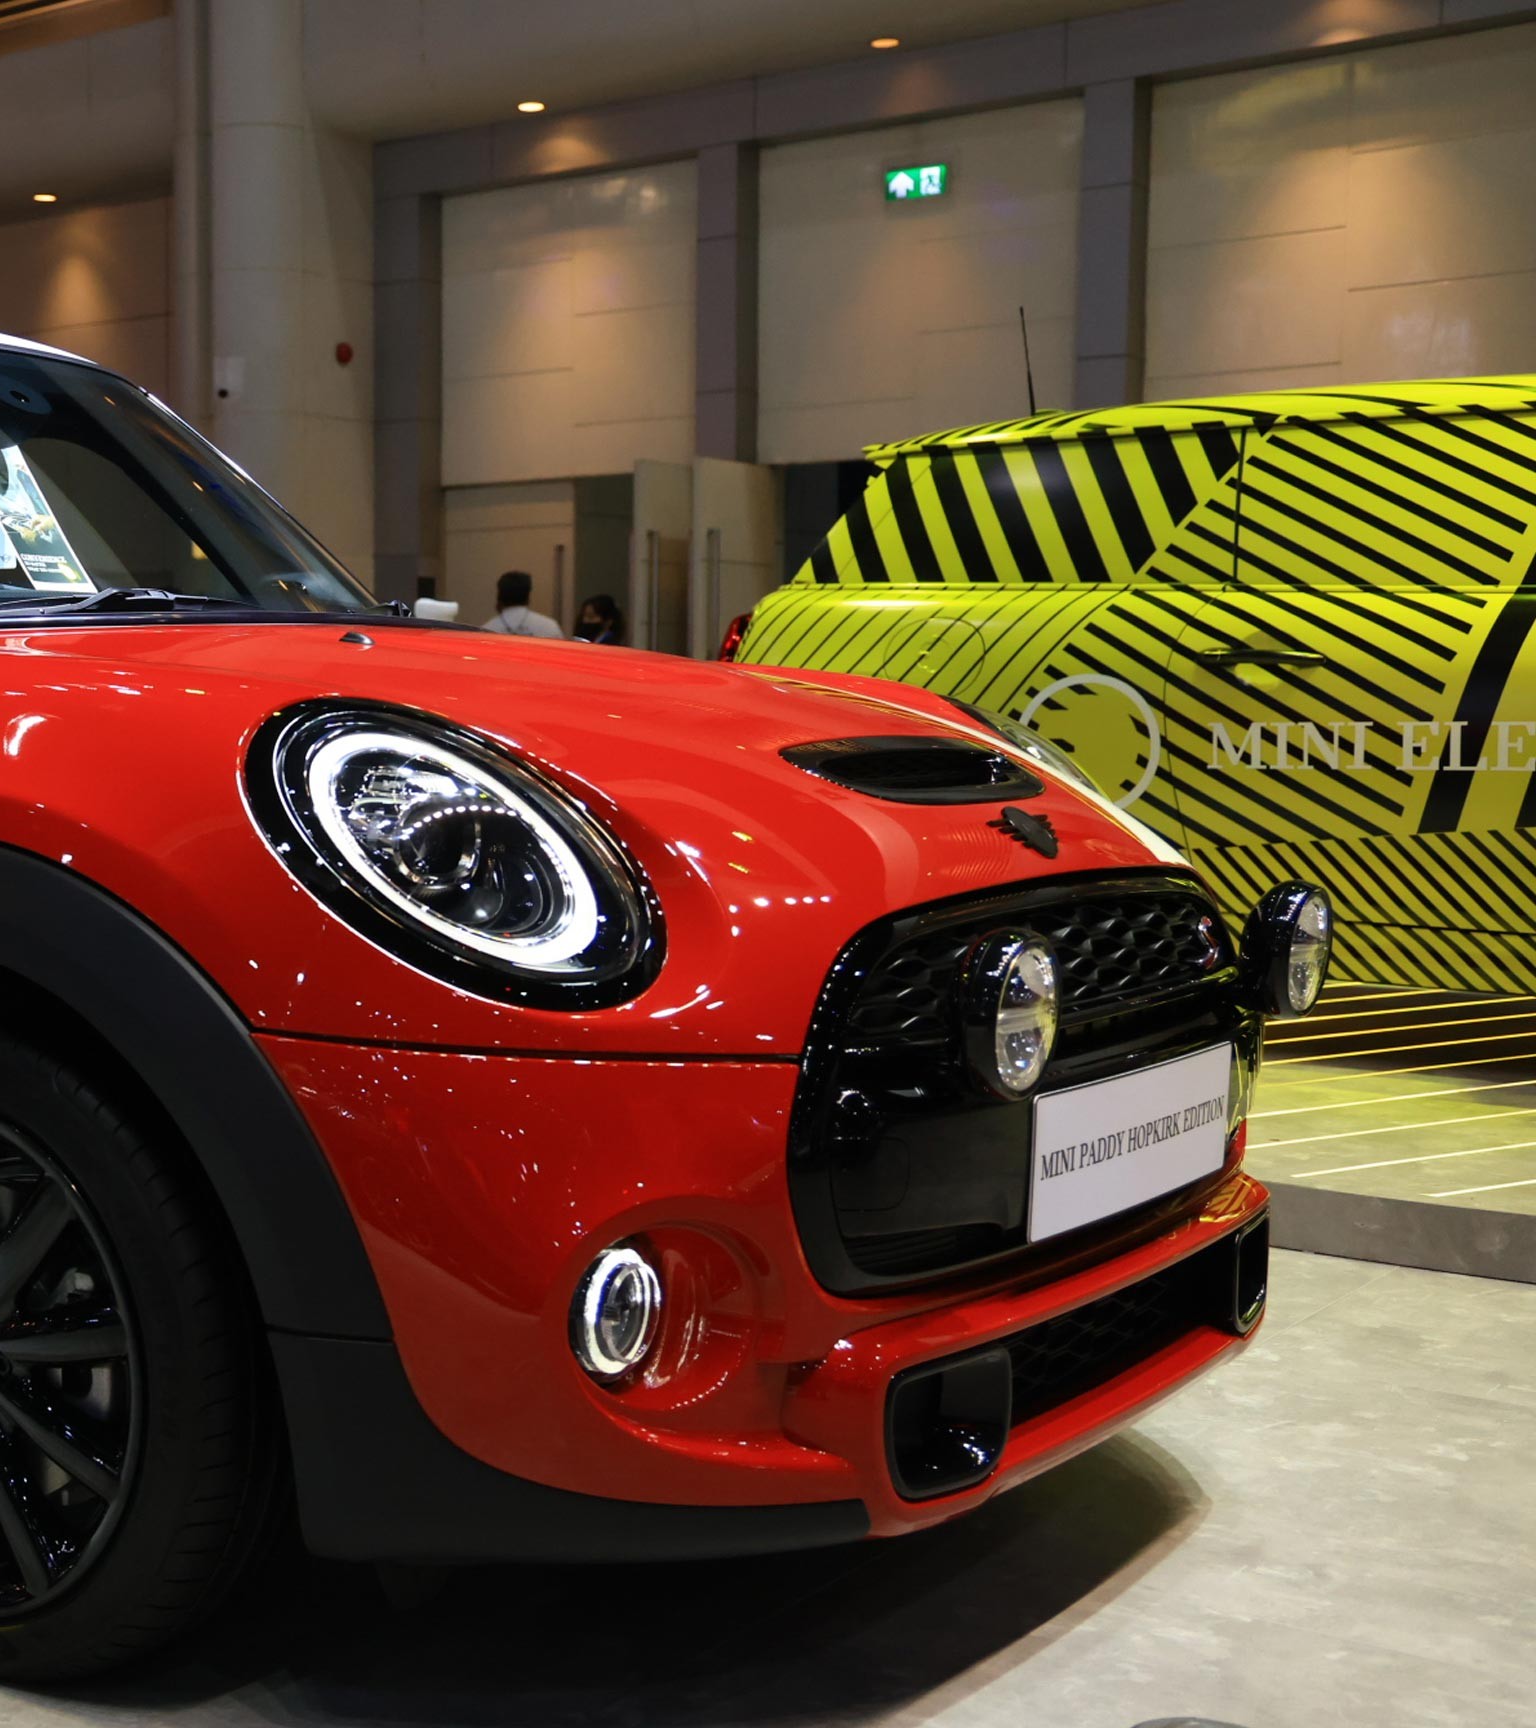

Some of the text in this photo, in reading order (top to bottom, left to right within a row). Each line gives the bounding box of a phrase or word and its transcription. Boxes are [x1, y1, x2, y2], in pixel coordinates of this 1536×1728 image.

[1206, 720, 1374, 770] MINI
[1040, 1095, 1225, 1181] MINI PADDY HOPKIRK EDITION
